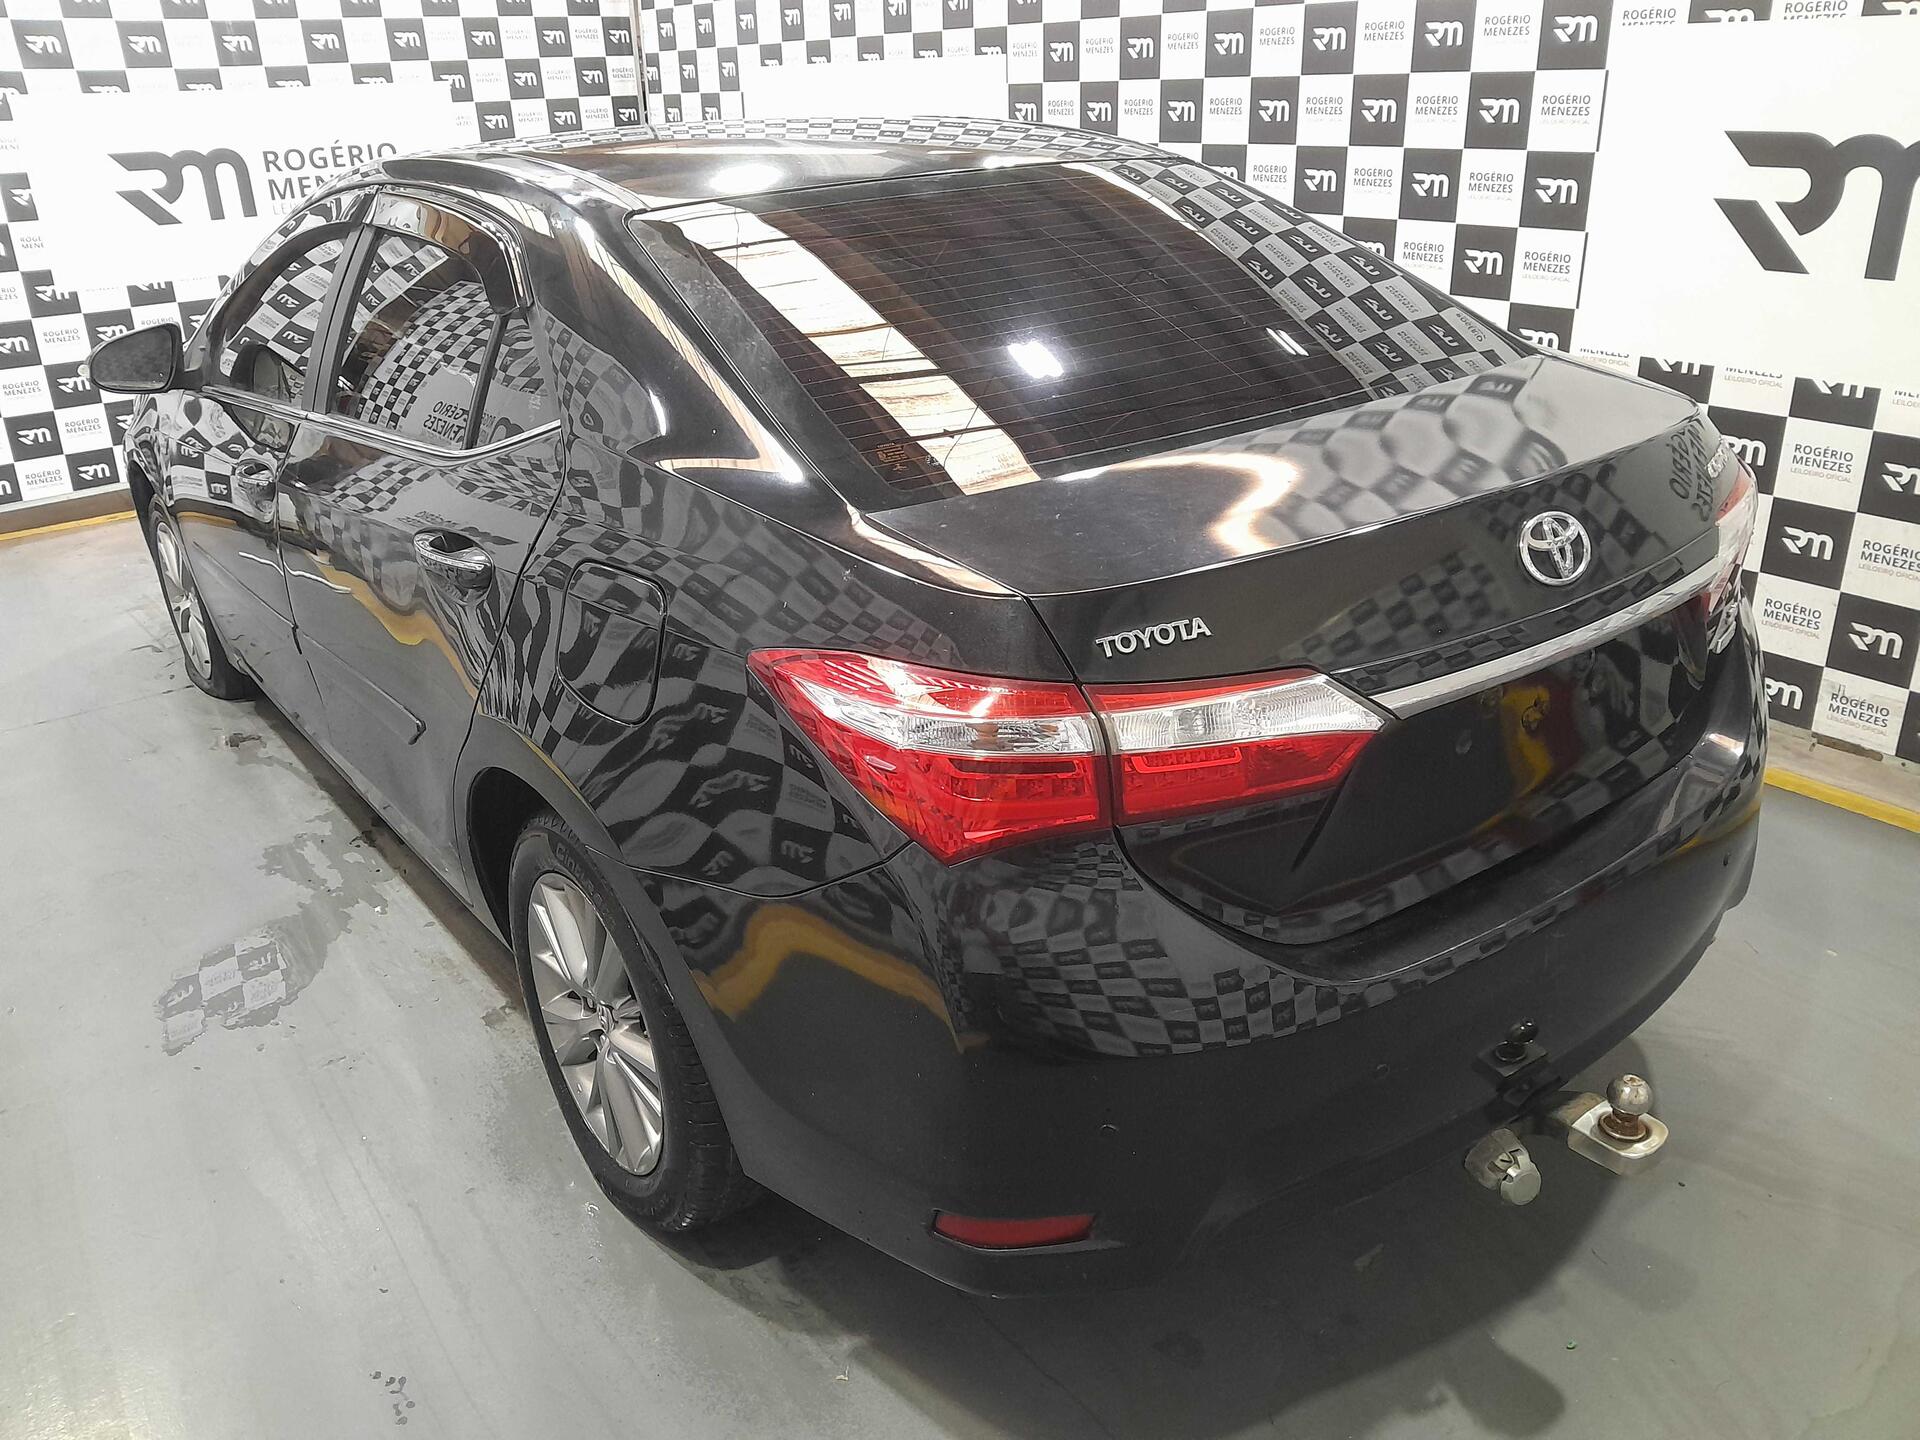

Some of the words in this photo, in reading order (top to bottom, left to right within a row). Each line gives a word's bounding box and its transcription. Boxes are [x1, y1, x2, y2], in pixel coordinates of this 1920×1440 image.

[1364, 30, 1405, 42] MENEZES
[1483, 24, 1530, 37] MENEZES
[1167, 41, 1199, 51] MENEZES
[1259, 35, 1295, 46] MENEZES
[1124, 106, 1153, 116] MENEZES
[1209, 106, 1243, 116] MENEZES
[1305, 105, 1344, 116] MENEZES
[1414, 104, 1459, 116] MENEZES
[1540, 104, 1590, 117] MENEZES
[1253, 173, 1288, 184] MENEZES
[1352, 177, 1393, 189] MENEZES
[1468, 181, 1513, 194] MENEZES
[1402, 250, 1444, 264] MENEZES
[1524, 250, 1571, 265] ROGÉRIO
[1522, 260, 1570, 276] MENEZES
[3, 386, 42, 397] MENEZES
[66, 423, 101, 435] MENEZES
[1794, 443, 1854, 463] ROGÉRIO
[1791, 454, 1852, 475] MENEZES
[26, 475, 63, 487] MENEZES
[1790, 467, 1824, 479] LEILOEIRO
[1826, 471, 1853, 484] OFICIAL
[1765, 597, 1822, 620] ROGÉRIO
[1763, 607, 1821, 631] MENEZES
[1096, 617, 1212, 658] TOYOTA
[1831, 692, 1890, 718] ROGÉRIO
[1828, 702, 1888, 729] MENEZES
